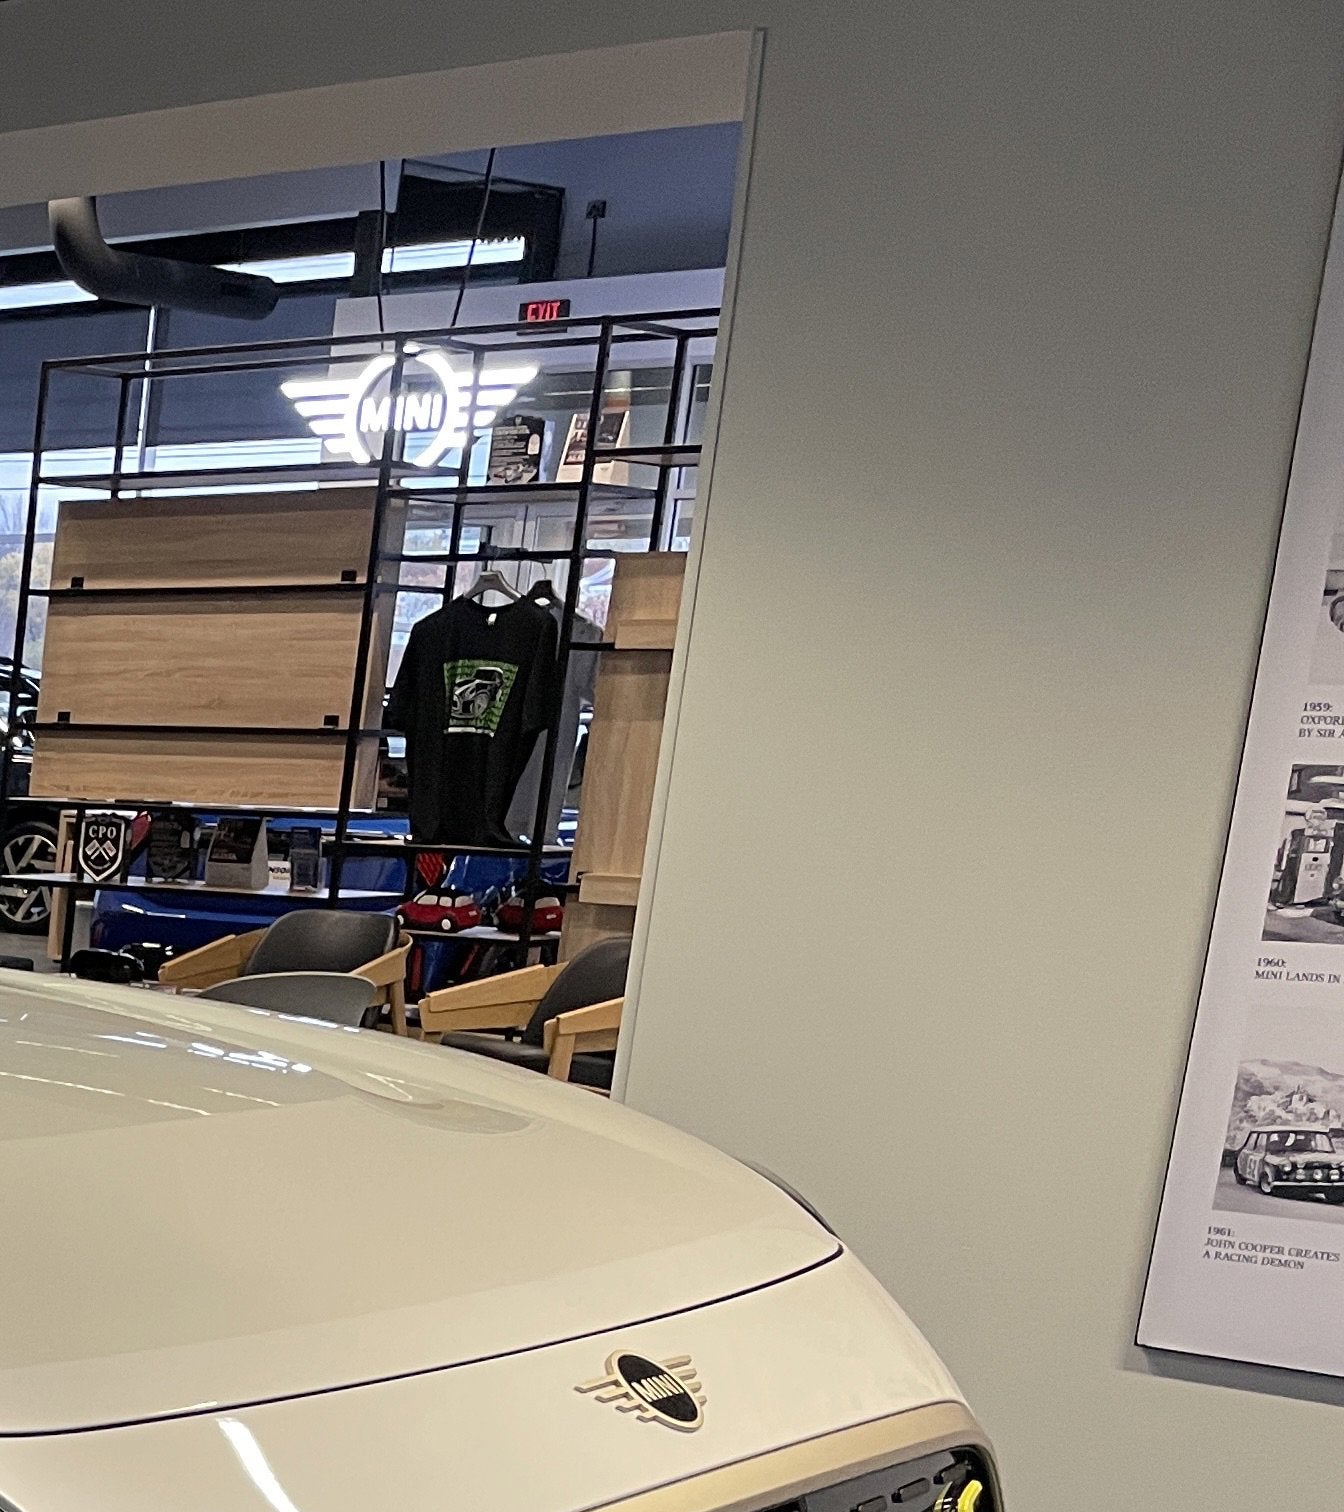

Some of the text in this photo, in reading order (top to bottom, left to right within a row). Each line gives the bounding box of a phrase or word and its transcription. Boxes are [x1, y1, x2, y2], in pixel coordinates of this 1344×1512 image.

[527, 301, 561, 322] EXIT
[359, 393, 444, 433] MINI
[1303, 702, 1333, 712] 1959:
[1300, 715, 1344, 725] OXFOR
[1298, 728, 1312, 738] BY
[88, 824, 117, 839] CPO
[1254, 969, 1341, 984] MINI LANDS IN
[1204, 1237, 1341, 1262] JOHN COOPER CREATES
[1214, 1250, 1258, 1265] RACING
[1260, 1256, 1305, 1270] DEMON
[630, 1373, 685, 1403] MINI
